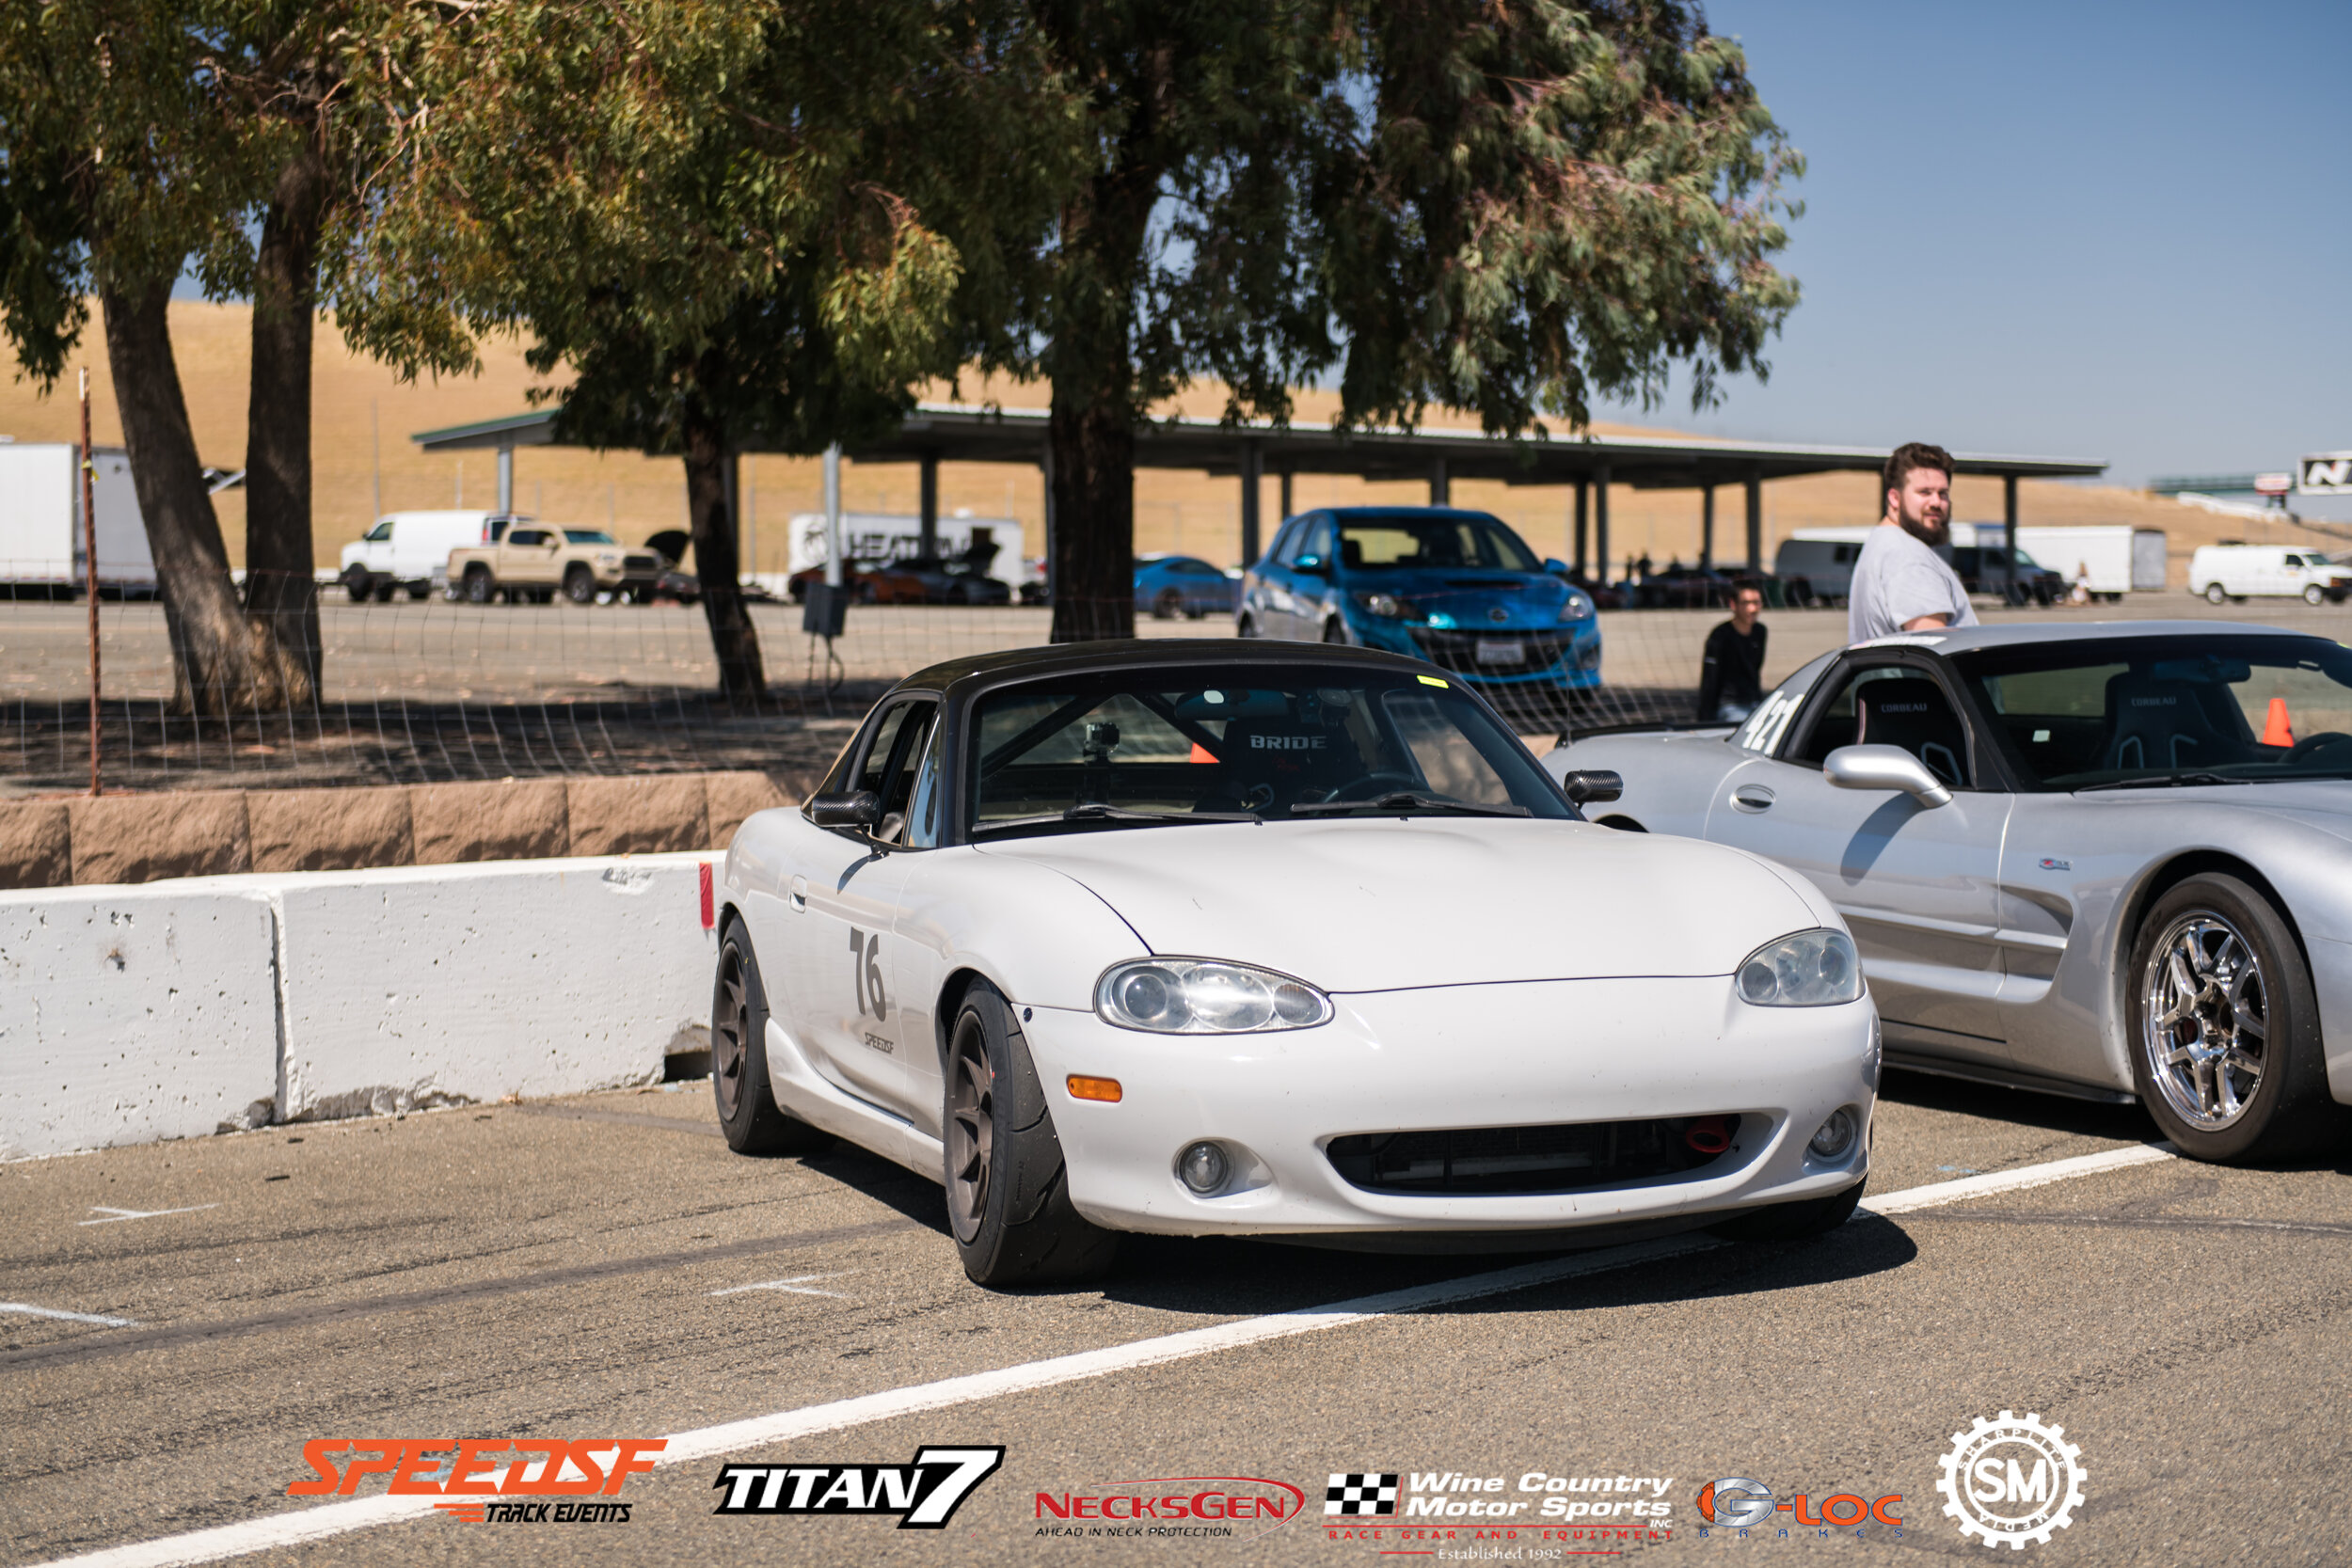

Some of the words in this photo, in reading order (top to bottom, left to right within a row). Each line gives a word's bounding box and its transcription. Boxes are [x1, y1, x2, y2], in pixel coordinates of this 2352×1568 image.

[1249, 735, 1327, 750] BRIDE
[1742, 689, 1805, 756] 421
[850, 926, 886, 1022] 76
[865, 1032, 894, 1054] SPEEDSF
